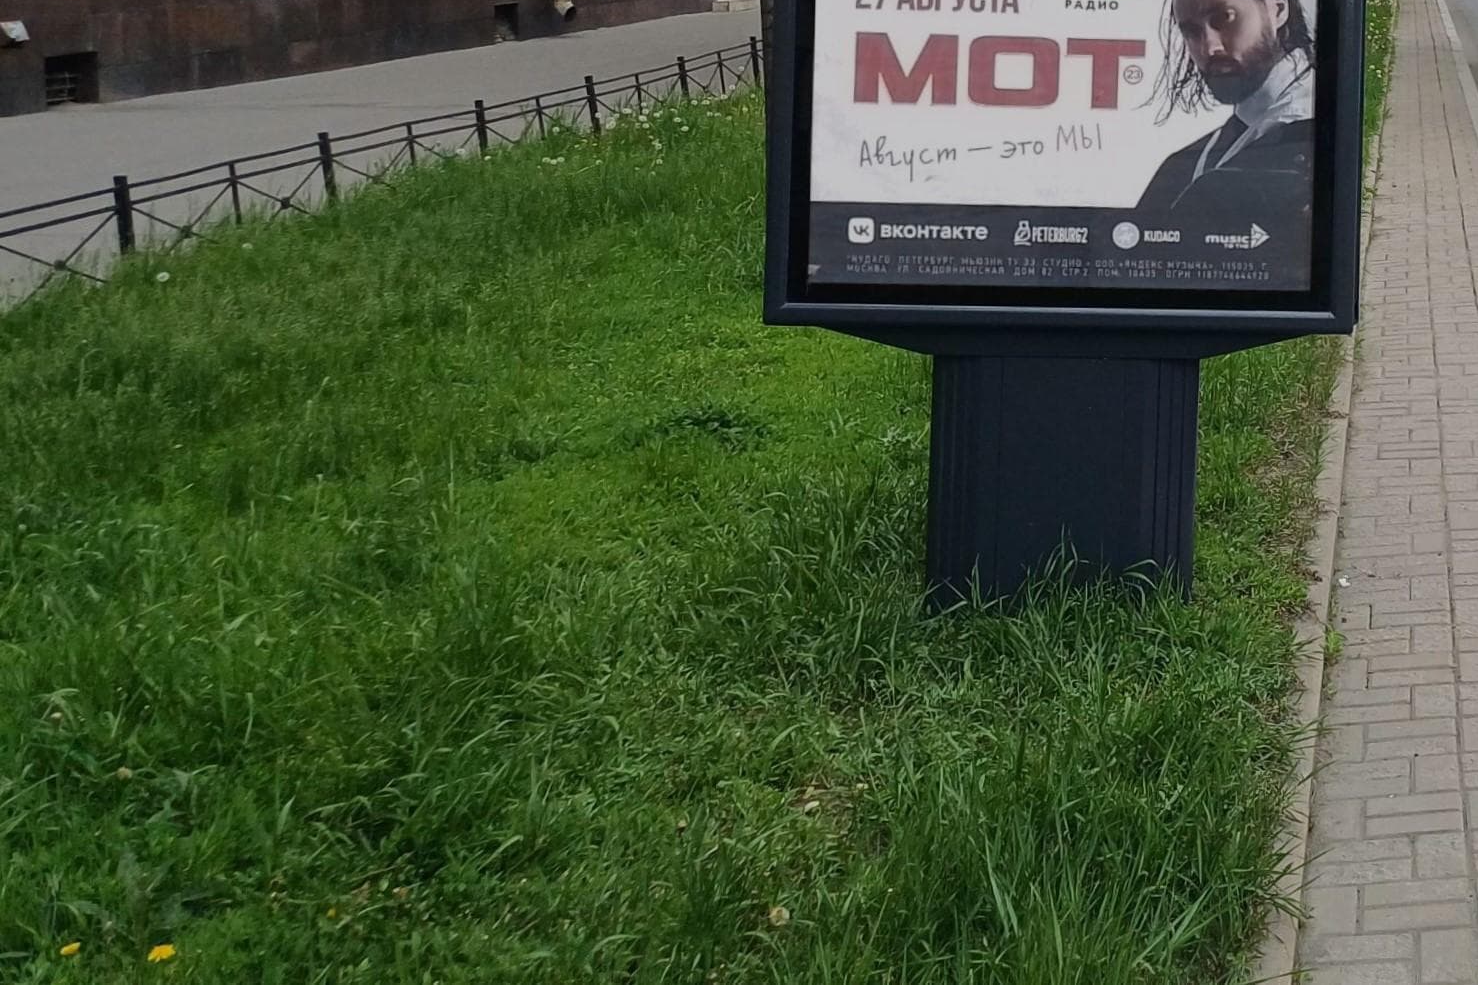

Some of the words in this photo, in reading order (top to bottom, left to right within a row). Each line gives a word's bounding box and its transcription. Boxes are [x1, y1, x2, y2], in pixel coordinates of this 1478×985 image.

[1064, 0, 1120, 11] РАДИО
[853, 31, 1146, 109] МОТ
[859, 135, 958, 183] Август
[999, 140, 1045, 159] это
[1055, 123, 1103, 153] МЫ
[1031, 225, 1089, 245] PETERBURG2
[1143, 229, 1181, 243] KUDAGO
